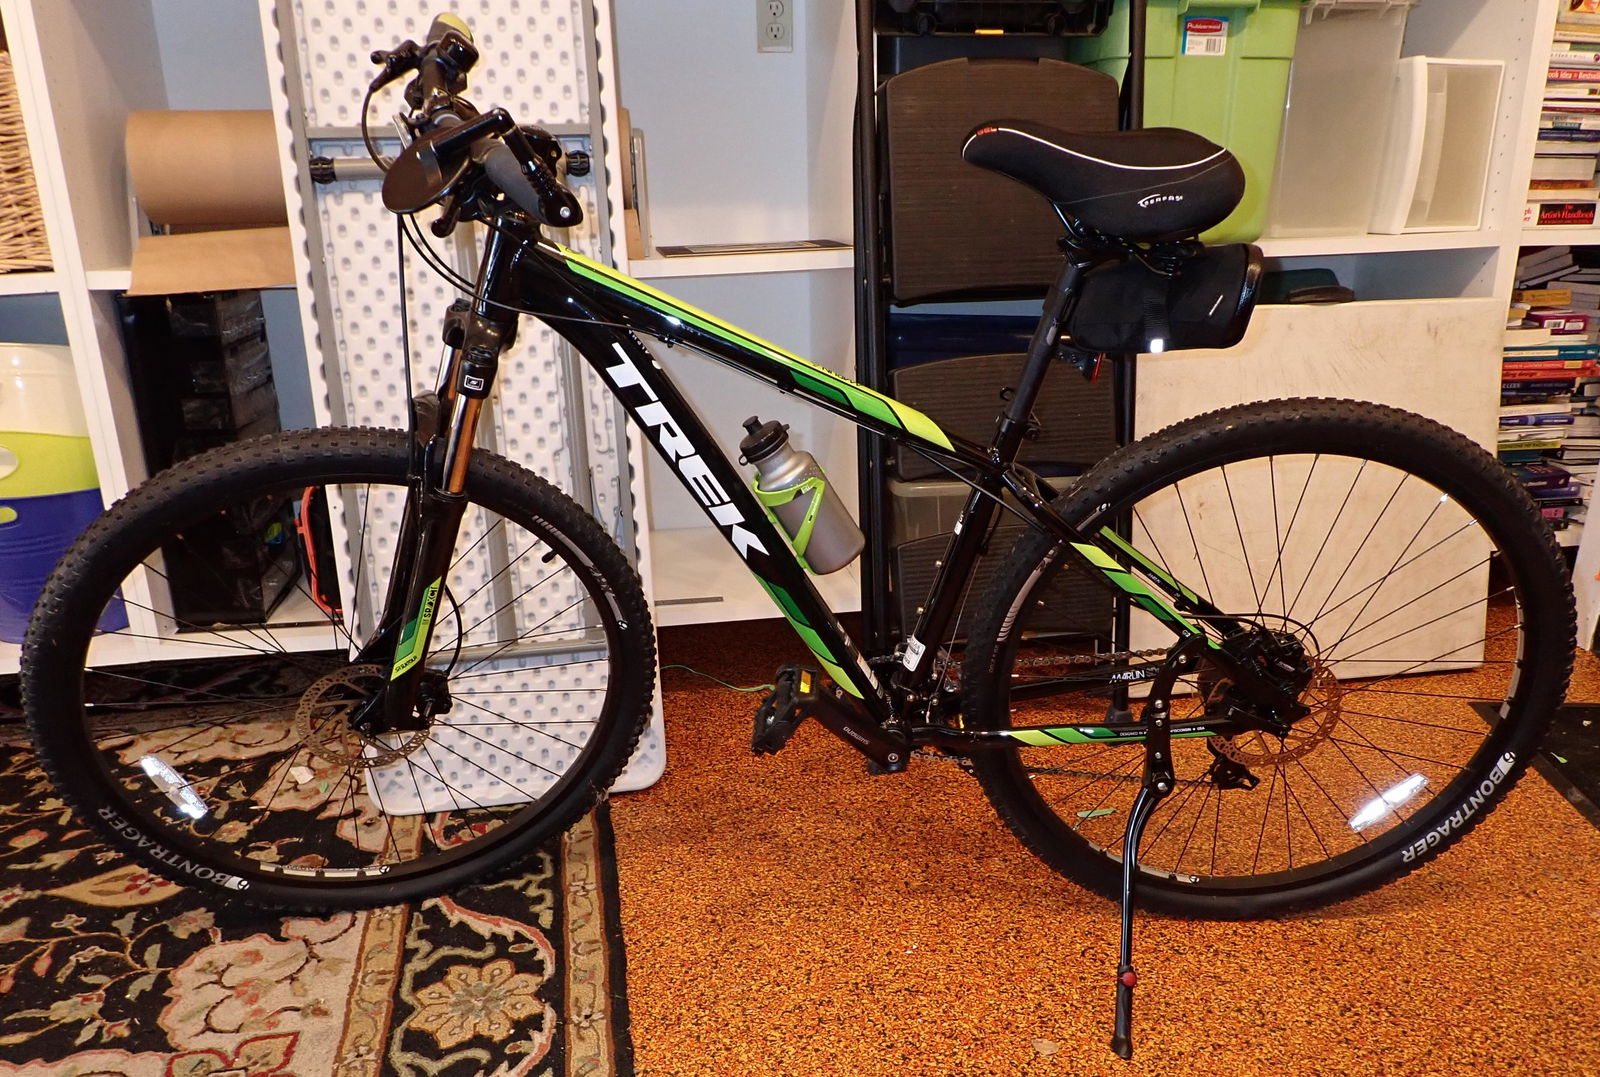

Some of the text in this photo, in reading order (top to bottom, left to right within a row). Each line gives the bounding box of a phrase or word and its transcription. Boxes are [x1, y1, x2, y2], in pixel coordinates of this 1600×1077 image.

[605, 342, 770, 560] TREK
[98, 805, 227, 885] BONTRAGER
[1402, 769, 1505, 863] BONTRAGER
